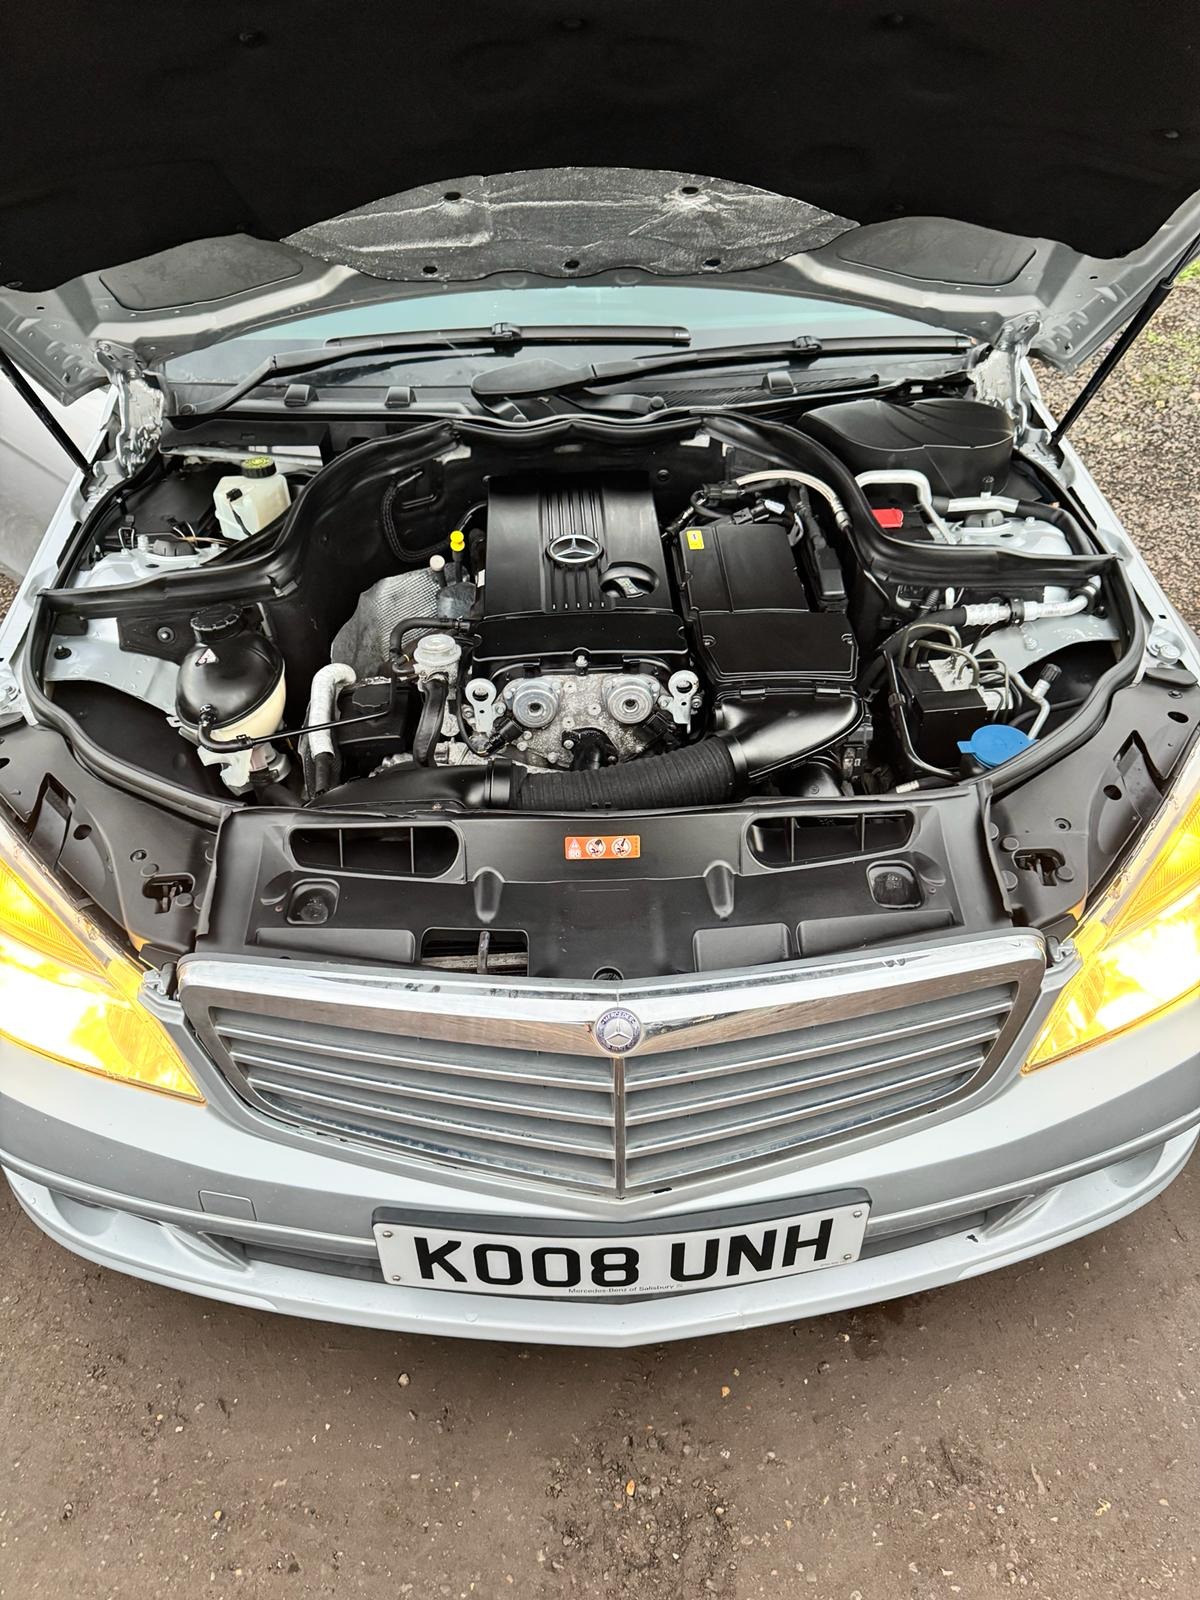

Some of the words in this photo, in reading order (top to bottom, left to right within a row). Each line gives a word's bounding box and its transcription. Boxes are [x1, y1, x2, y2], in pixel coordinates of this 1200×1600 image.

[414, 1236, 640, 1288] KO08
[670, 1218, 834, 1282] UNH
[639, 1284, 674, 1292] Salisbury
